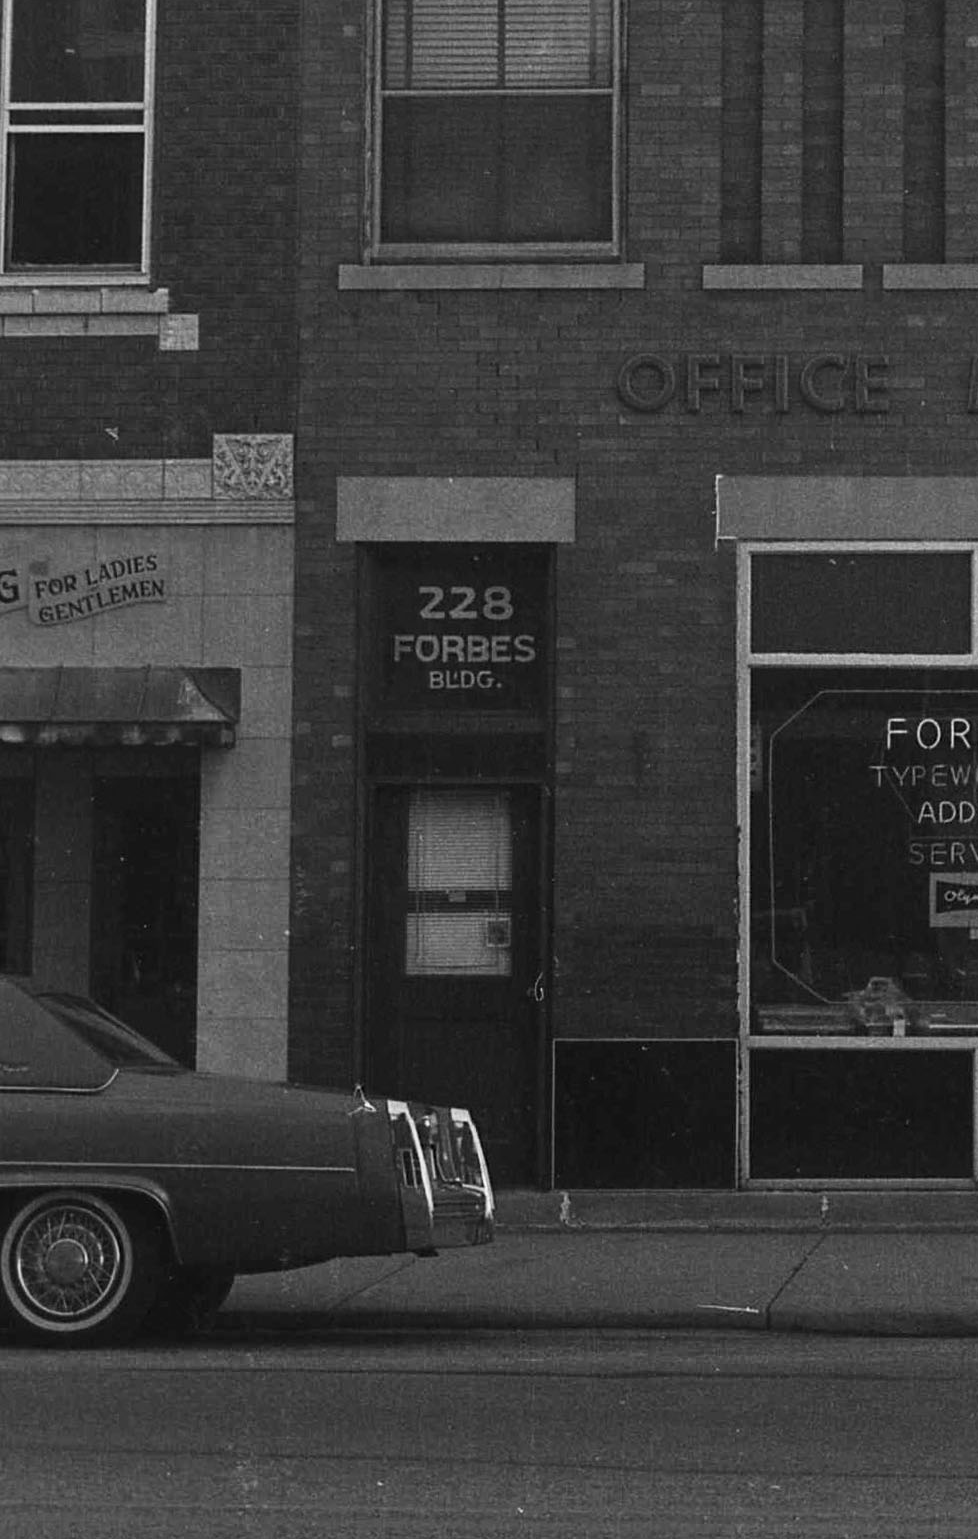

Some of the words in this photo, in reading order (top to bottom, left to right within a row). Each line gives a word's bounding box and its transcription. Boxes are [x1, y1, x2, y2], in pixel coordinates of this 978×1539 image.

[615, 352, 891, 414] OFFICE
[34, 573, 78, 599] FOR
[85, 554, 158, 586] LADIES
[38, 579, 165, 623] GENTLEMEN
[418, 585, 515, 621] 228
[393, 634, 537, 663] FORBES
[428, 670, 503, 690] BLDG.
